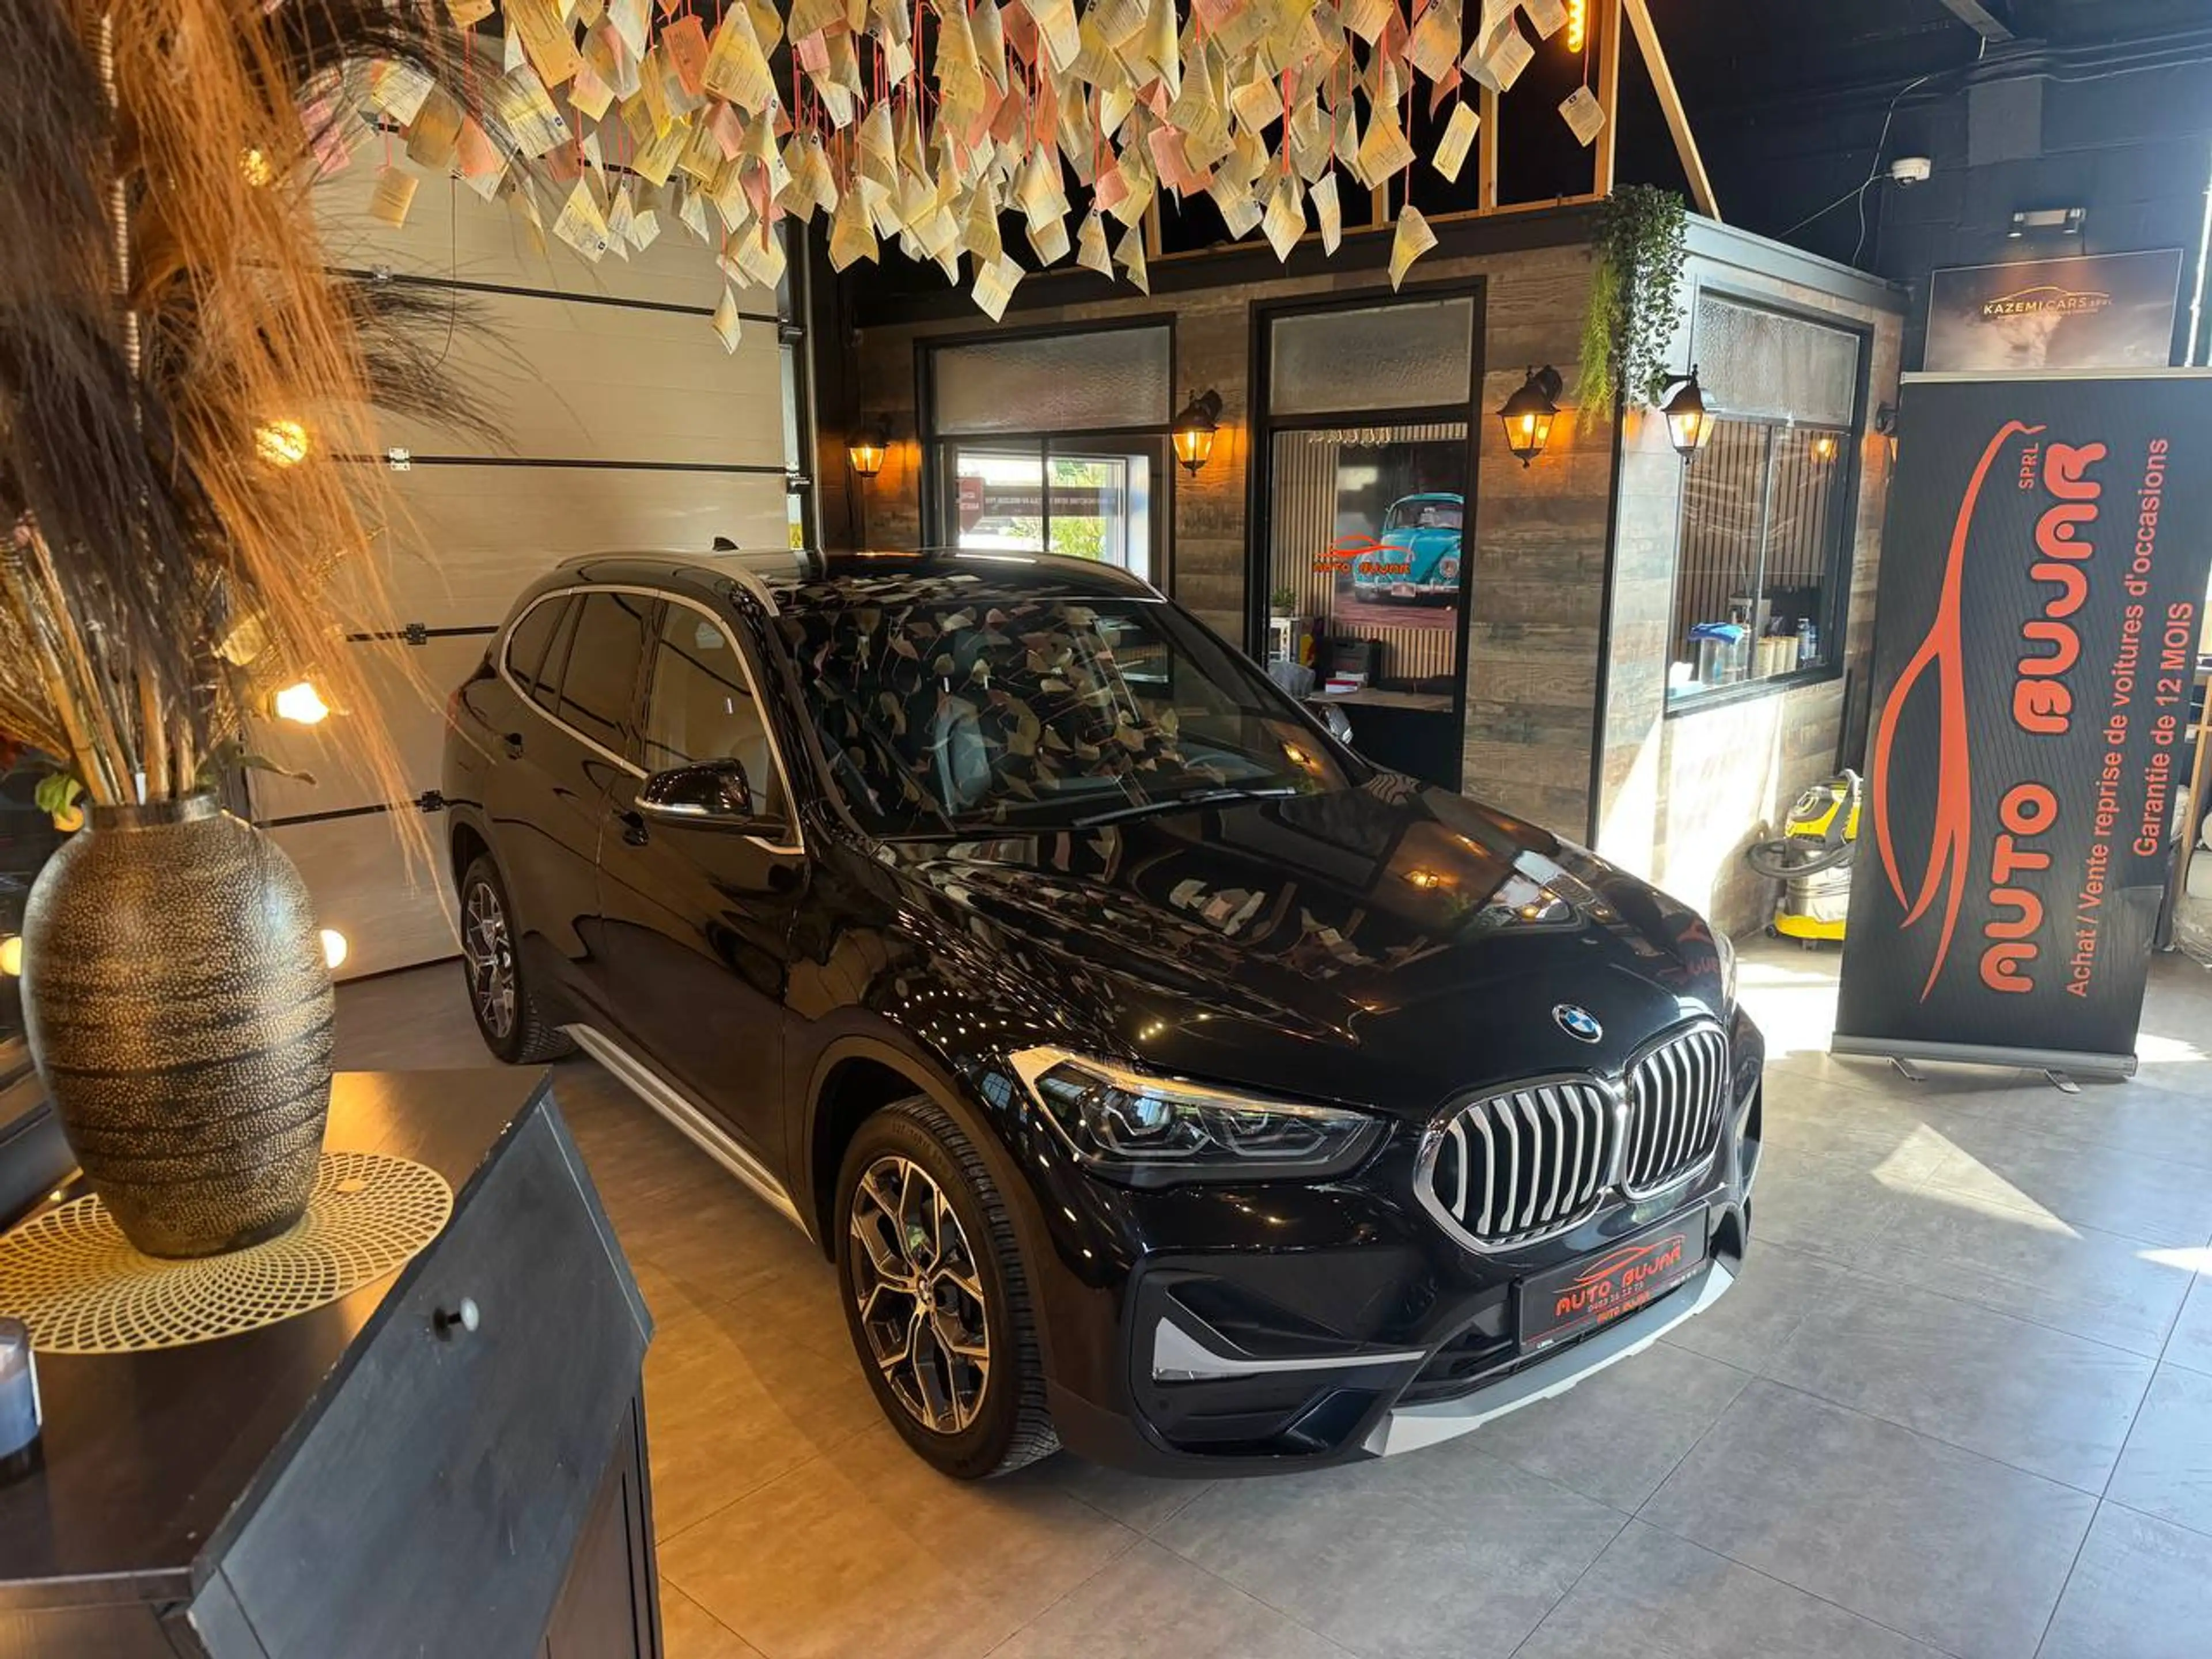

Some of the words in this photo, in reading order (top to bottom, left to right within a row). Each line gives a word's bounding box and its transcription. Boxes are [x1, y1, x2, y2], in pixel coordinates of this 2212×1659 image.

[1983, 301, 2043, 315] KAZEMI
[2046, 297, 2087, 311] CARS
[2019, 443, 2039, 488] SPRL
[2125, 438, 2169, 597] d'occasions
[1313, 562, 1351, 573] AUTO
[2013, 442, 2107, 733] BUJAR
[2111, 605, 2143, 707] voitures
[2160, 603, 2194, 676] MOIS
[2156, 679, 2180, 706] 12
[2103, 715, 2128, 745] de
[2152, 715, 2176, 746] de
[2094, 753, 2123, 837] reprise
[2133, 753, 2171, 857] Garantie
[1980, 783, 2059, 993] AUTO
[2078, 843, 2108, 909] Vente
[2075, 915, 2099, 925] /
[2067, 930, 2097, 997] Achat
[1555, 1281, 1612, 1316] AUTO
[1622, 1245, 1681, 1287] BUJAR
